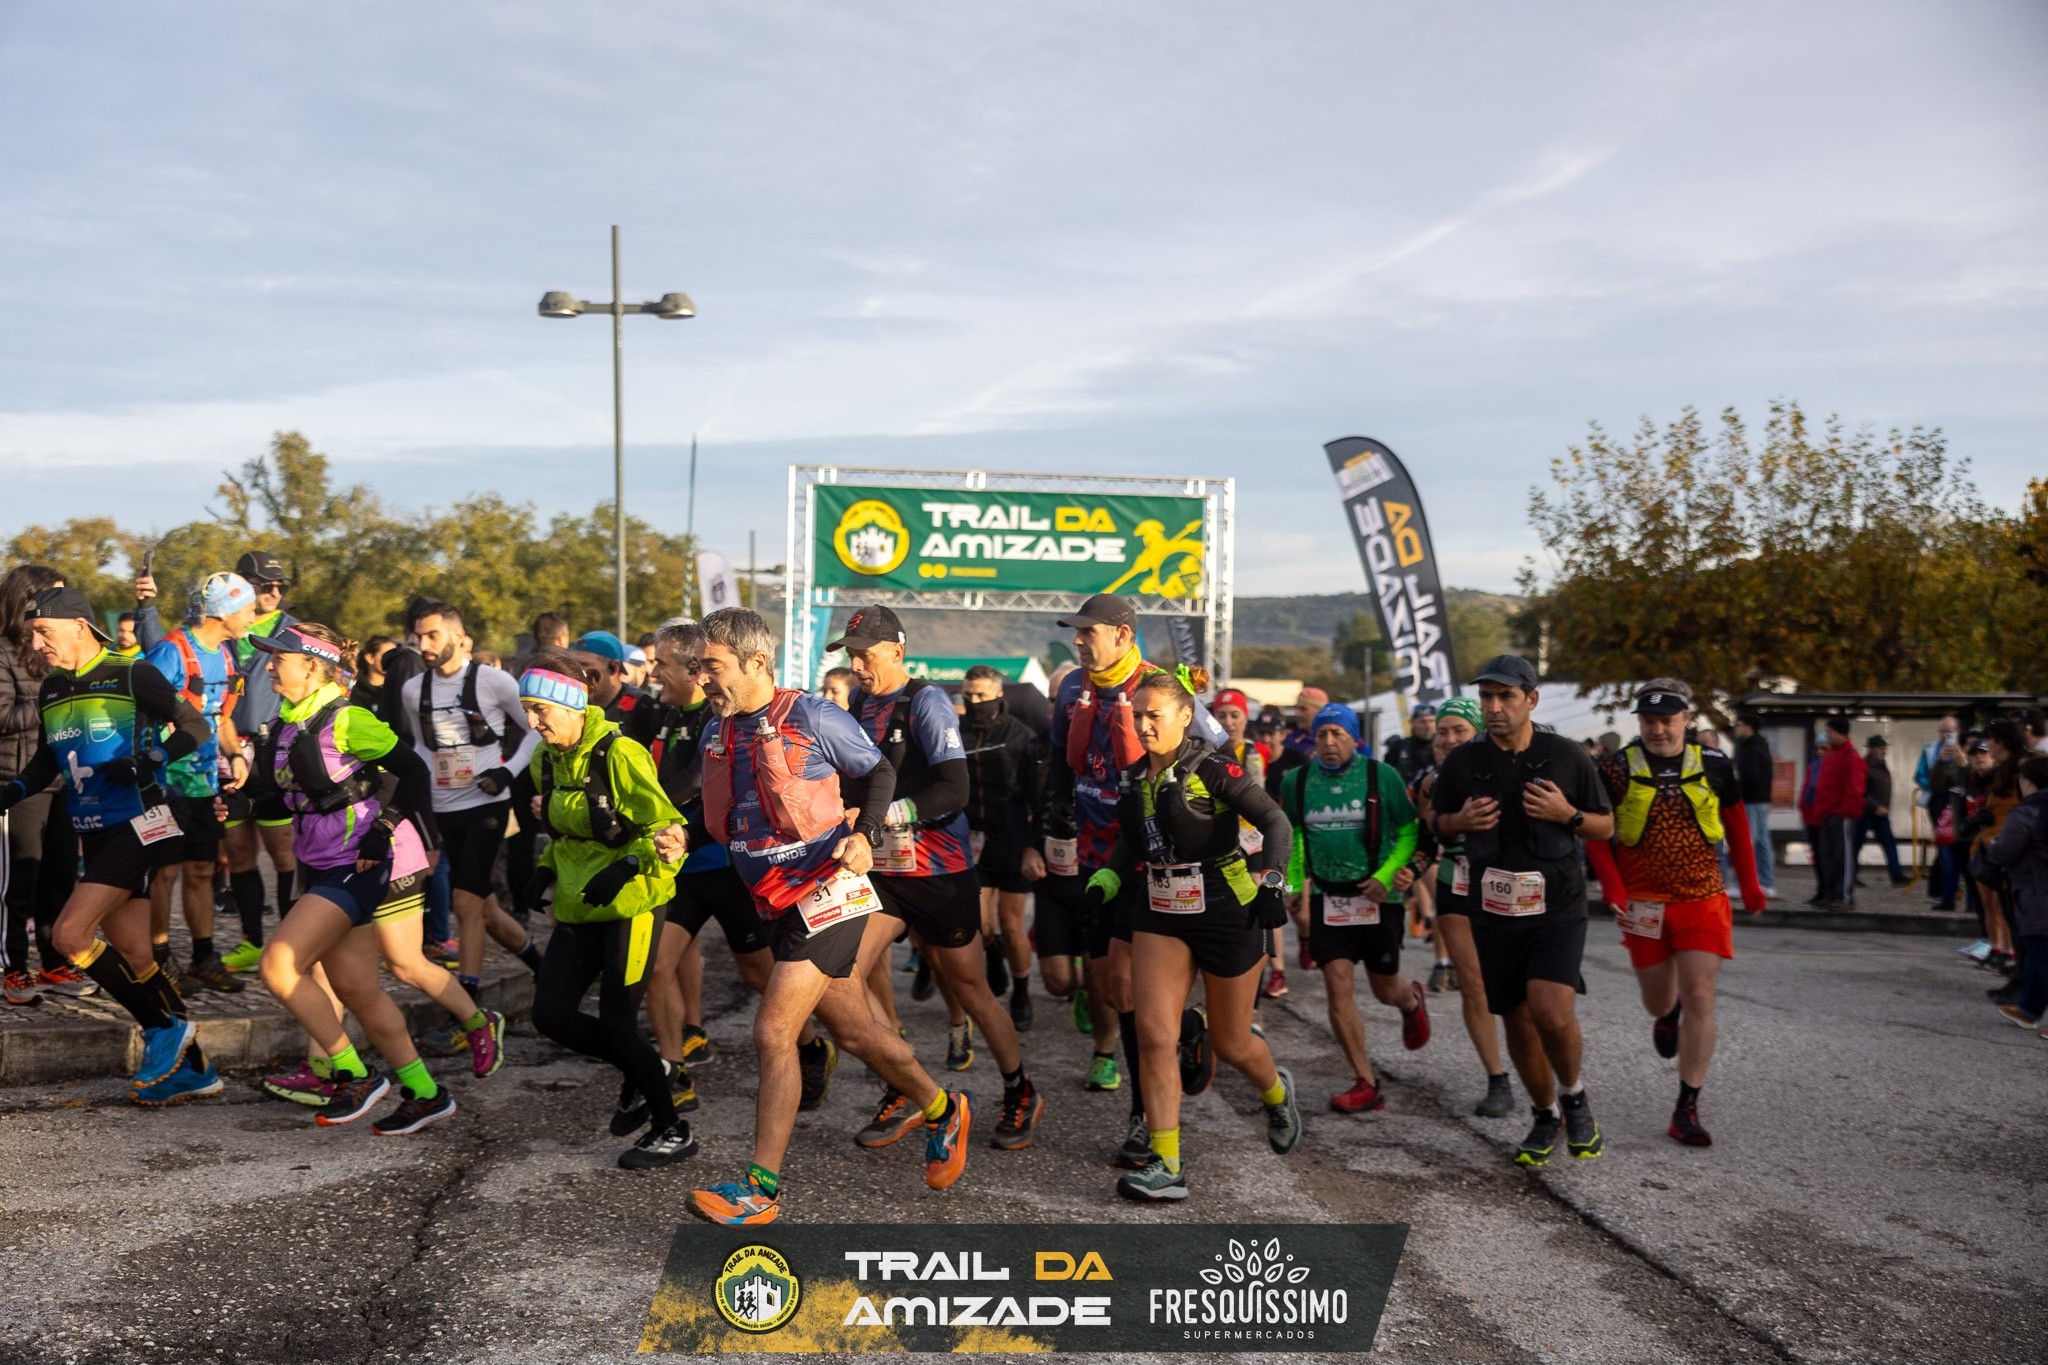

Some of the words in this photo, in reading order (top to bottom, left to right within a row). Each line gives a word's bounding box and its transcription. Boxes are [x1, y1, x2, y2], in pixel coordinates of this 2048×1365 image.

[921, 501, 1051, 531] TRAIL
[1055, 506, 1118, 533] DA
[919, 533, 1127, 563] AMIZADE
[143, 806, 163, 821] 131
[767, 846, 808, 865] MINDE
[811, 885, 832, 902] 31
[1488, 879, 1512, 895] 160
